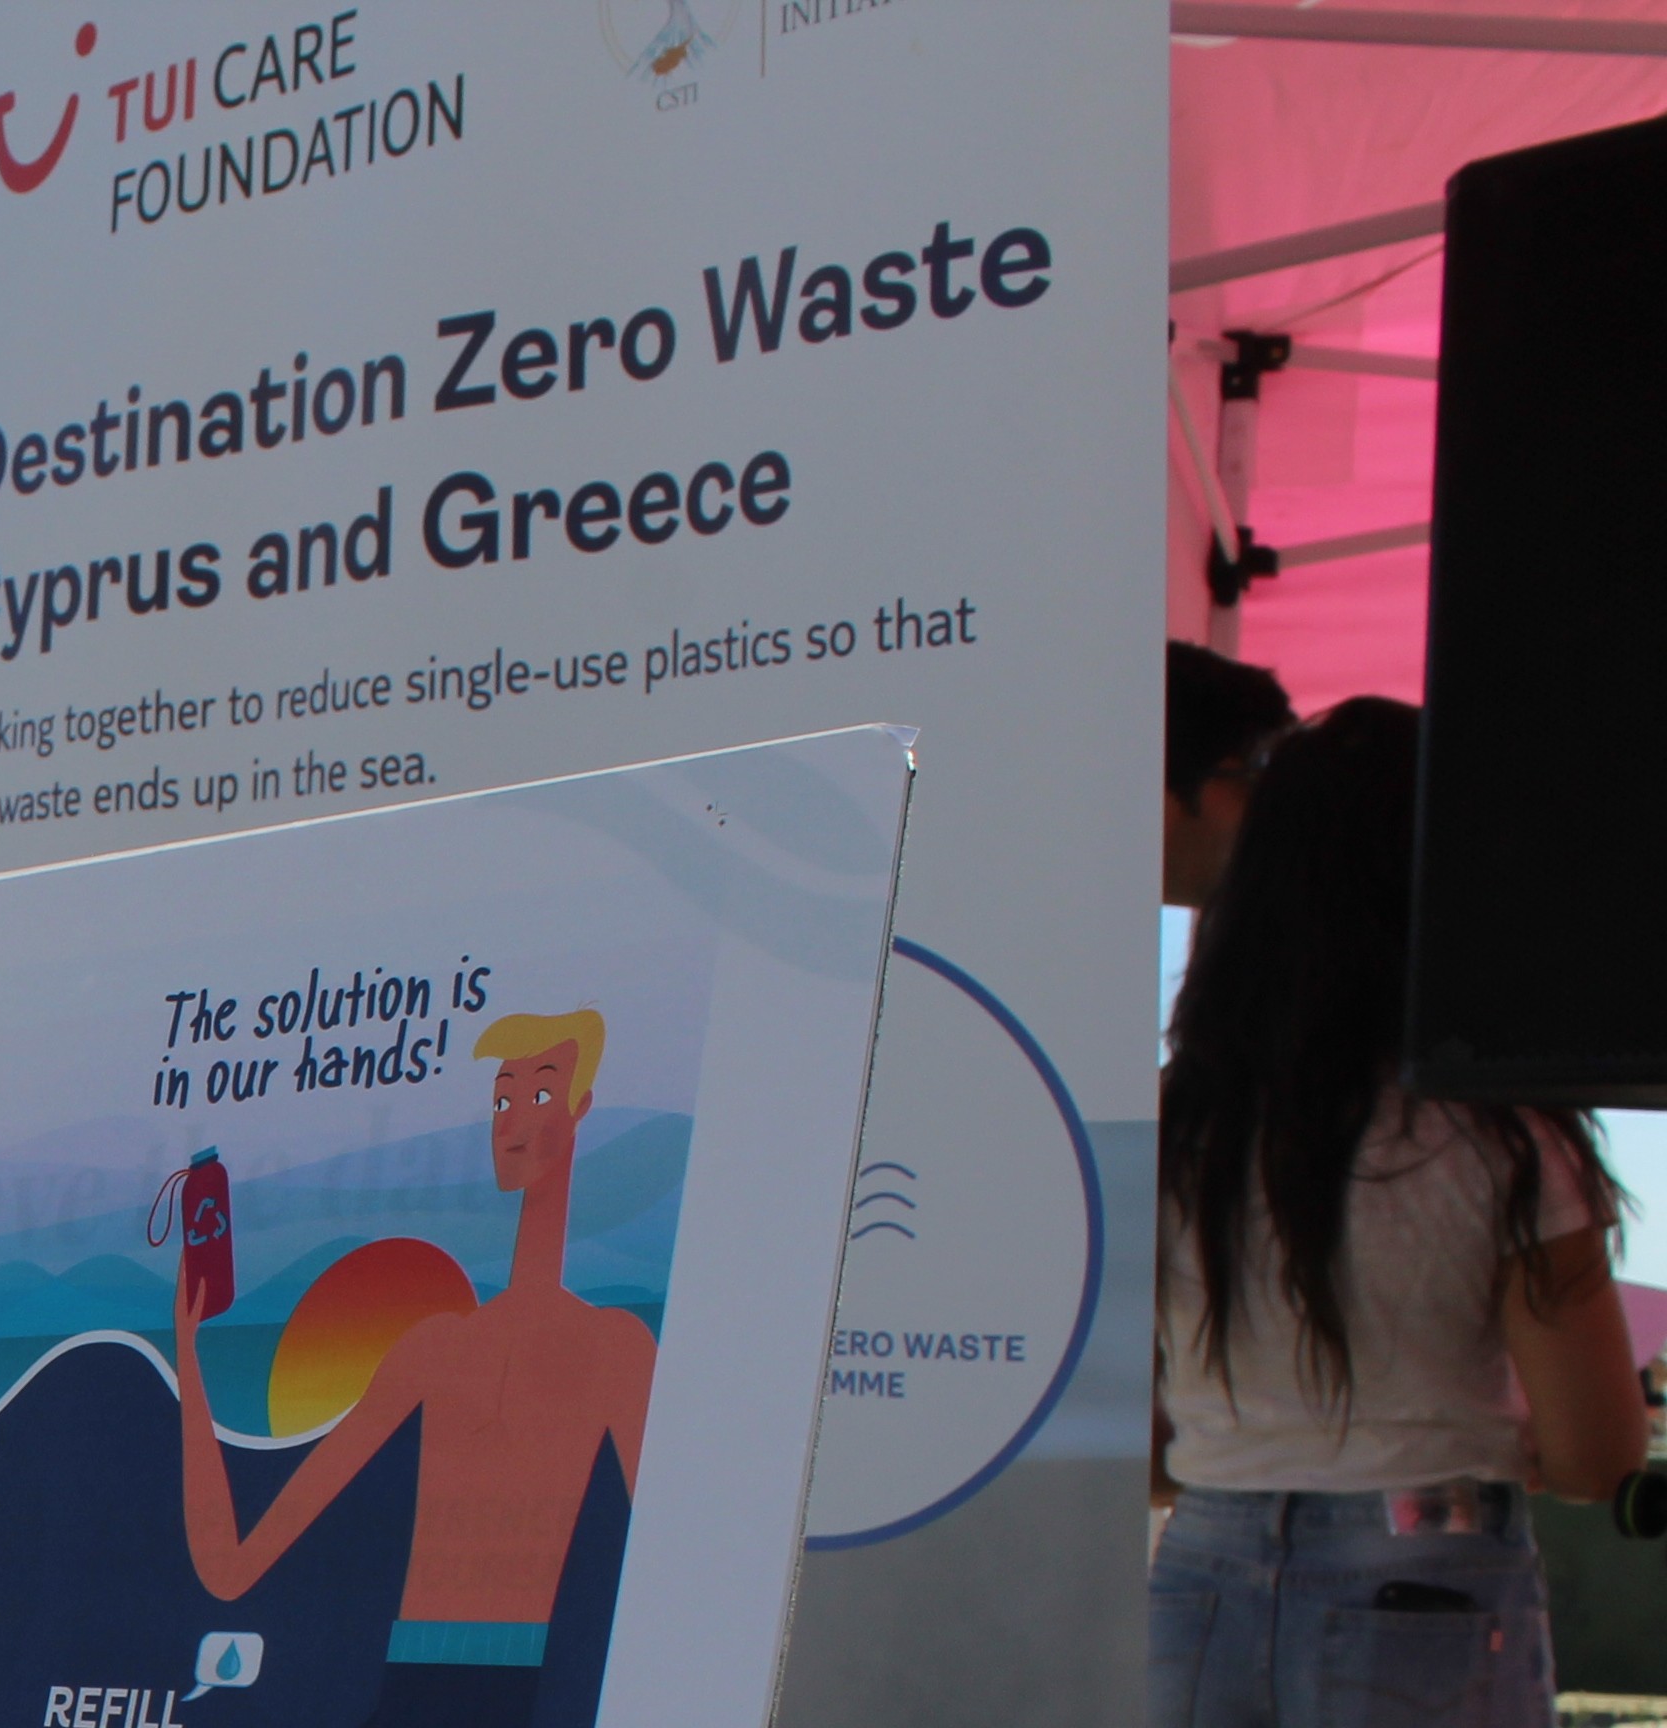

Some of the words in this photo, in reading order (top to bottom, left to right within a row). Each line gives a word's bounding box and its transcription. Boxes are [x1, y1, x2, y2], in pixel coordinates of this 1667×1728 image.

[108, 57, 196, 143] TUI
[214, 8, 358, 109] CARE
[655, 82, 699, 112] CSTI
[111, 73, 465, 235] FOUNDATION
[434, 304, 677, 413] Zero
[703, 219, 1053, 365] Waste
[246, 485, 394, 601] and
[422, 446, 792, 570] Greece
[65, 688, 216, 751] together
[227, 686, 264, 726] to
[276, 667, 392, 720] reduce
[405, 655, 628, 711] single-use
[644, 619, 792, 696] plastics
[806, 619, 856, 662] so
[873, 597, 977, 653] that
[93, 765, 180, 815] ends
[193, 771, 238, 814] up
[252, 758, 280, 803] in
[293, 749, 347, 798] the
[360, 750, 437, 790] sea.
[166, 988, 237, 1049] The
[253, 967, 431, 1039] solution
[452, 955, 491, 1013] is
[153, 1055, 189, 1109] in
[206, 1059, 279, 1104] our
[294, 1018, 449, 1092] hands!
[830, 1368, 906, 1399] MME
[833, 1330, 894, 1358] ERO
[903, 1332, 1026, 1362] WASTE
